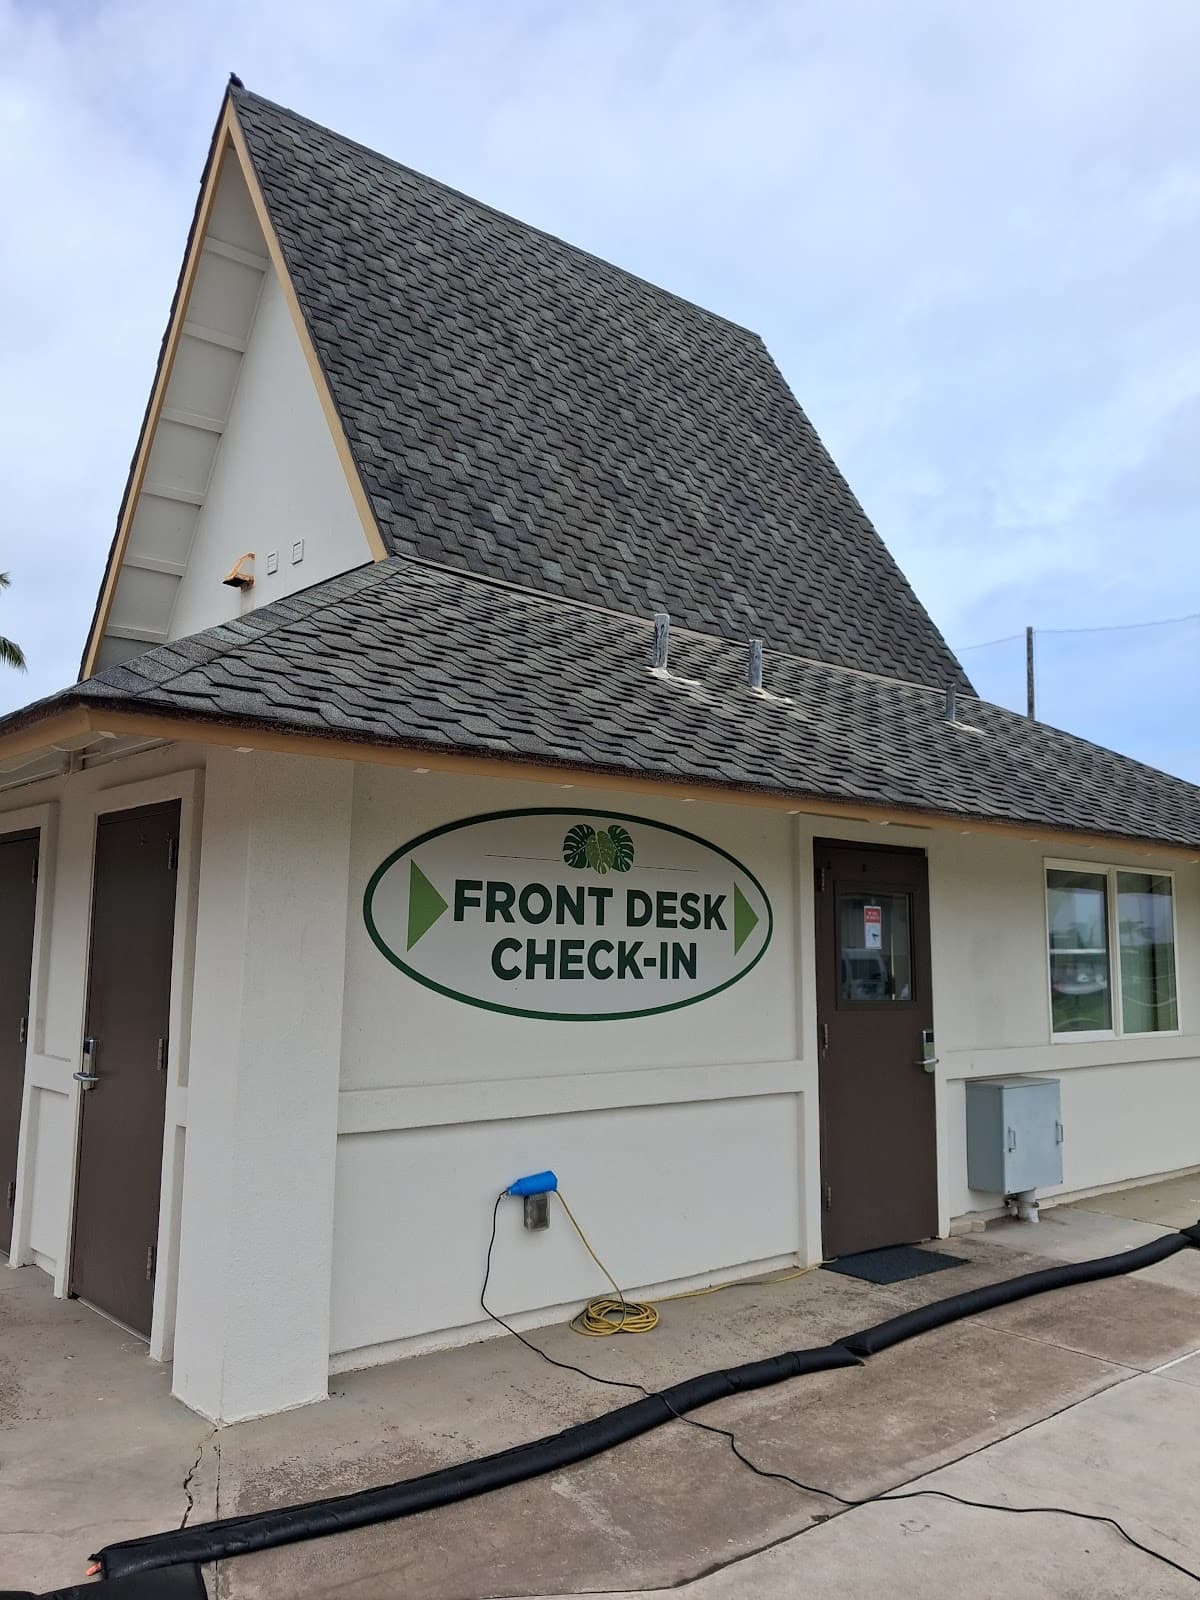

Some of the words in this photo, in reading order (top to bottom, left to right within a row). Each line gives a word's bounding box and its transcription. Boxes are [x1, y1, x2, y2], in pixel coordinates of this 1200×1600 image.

[453, 879, 613, 926] FRONT
[626, 889, 728, 931] DESK
[491, 937, 697, 980] CHECK-IN
